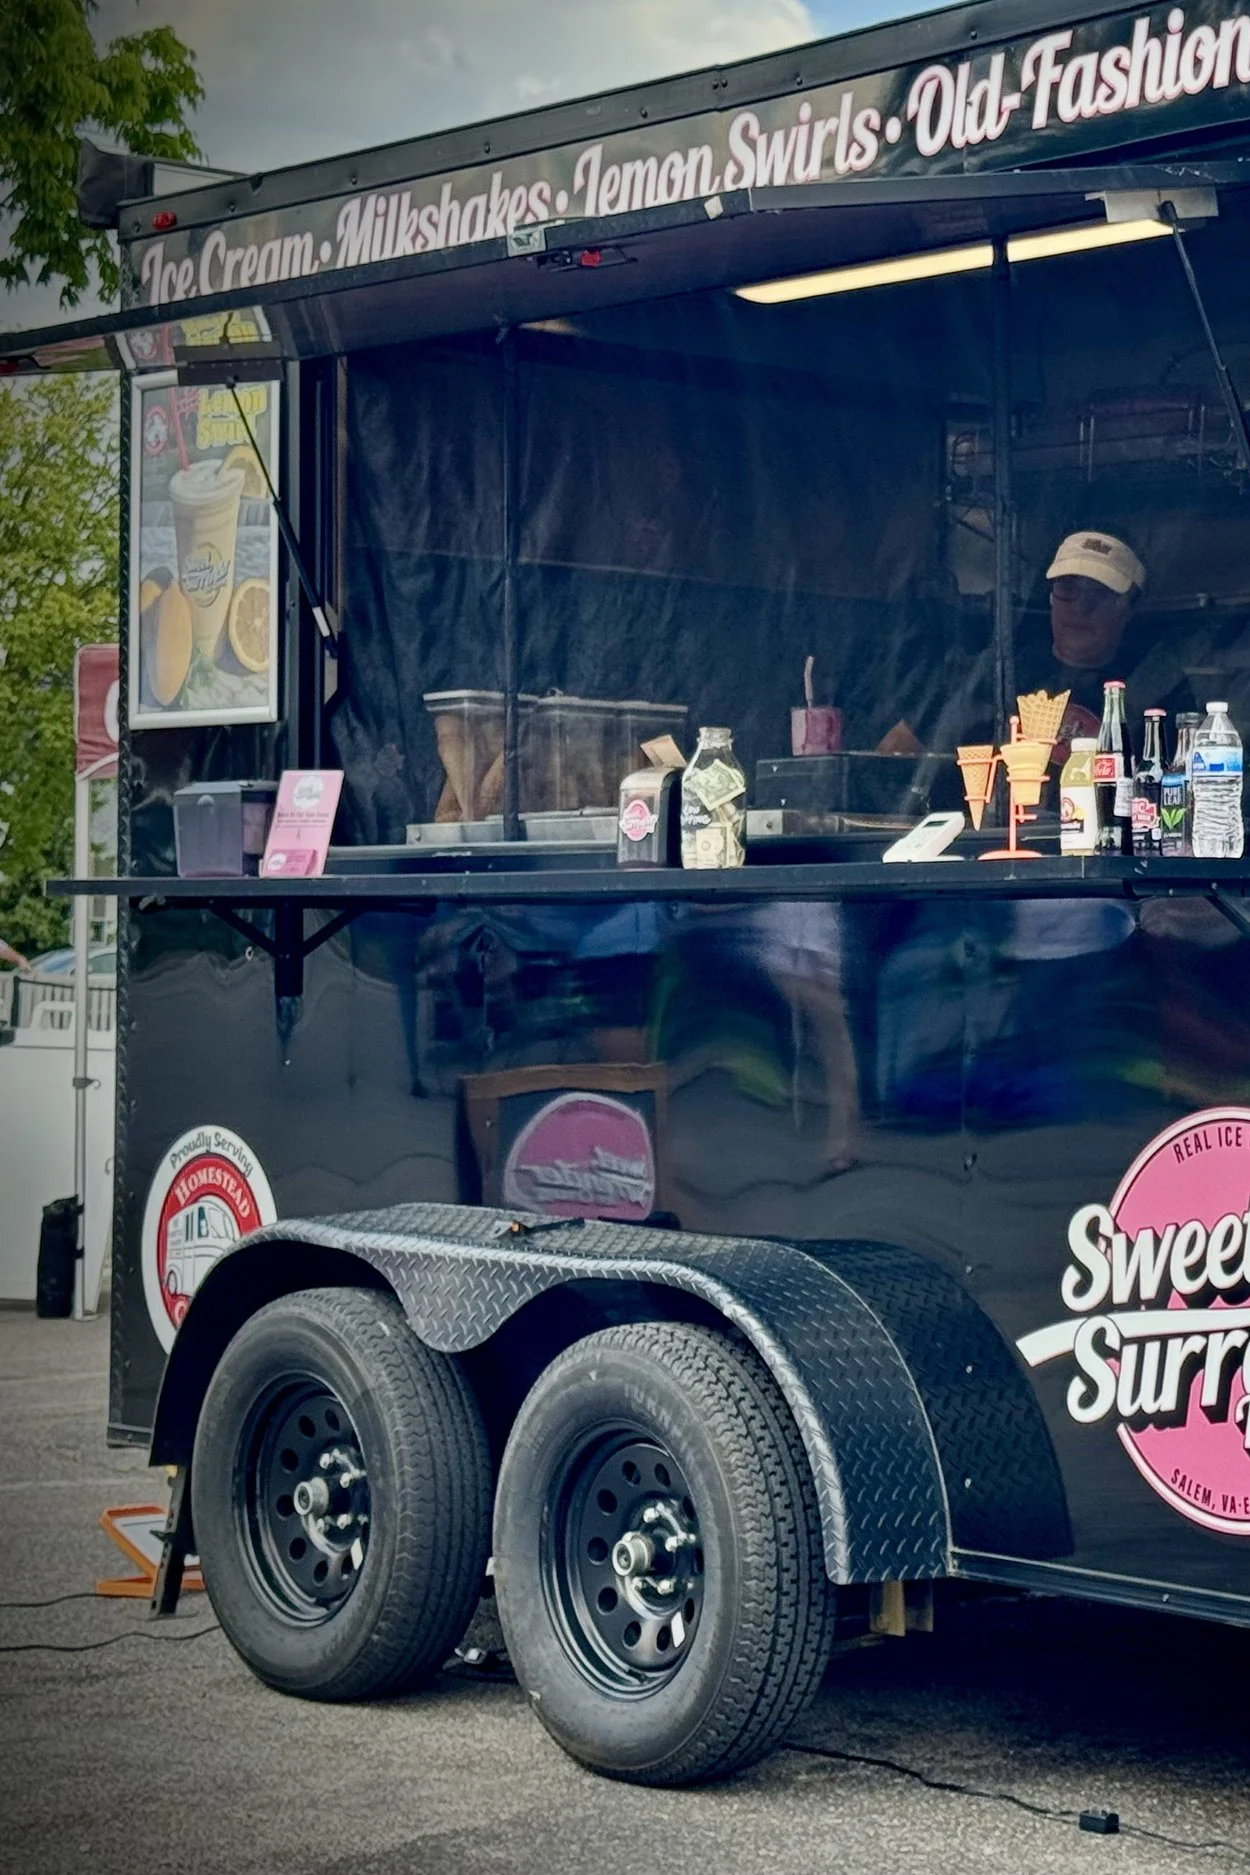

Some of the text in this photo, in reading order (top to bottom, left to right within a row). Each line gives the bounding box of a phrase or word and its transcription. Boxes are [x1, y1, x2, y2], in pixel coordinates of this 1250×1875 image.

[142, 241, 199, 307] Ice
[199, 230, 320, 297] Cream
[336, 172, 551, 269] Milkshakes
[573, 143, 721, 218] Lemon
[722, 91, 881, 188] Swirls
[1163, 795, 1181, 806] LEAF
[169, 1131, 253, 1178] Proudly Serving
[1173, 1131, 1212, 1164] REAL
[1217, 1126, 1243, 1148] ICE
[1170, 1468, 1216, 1510] SALEM,
